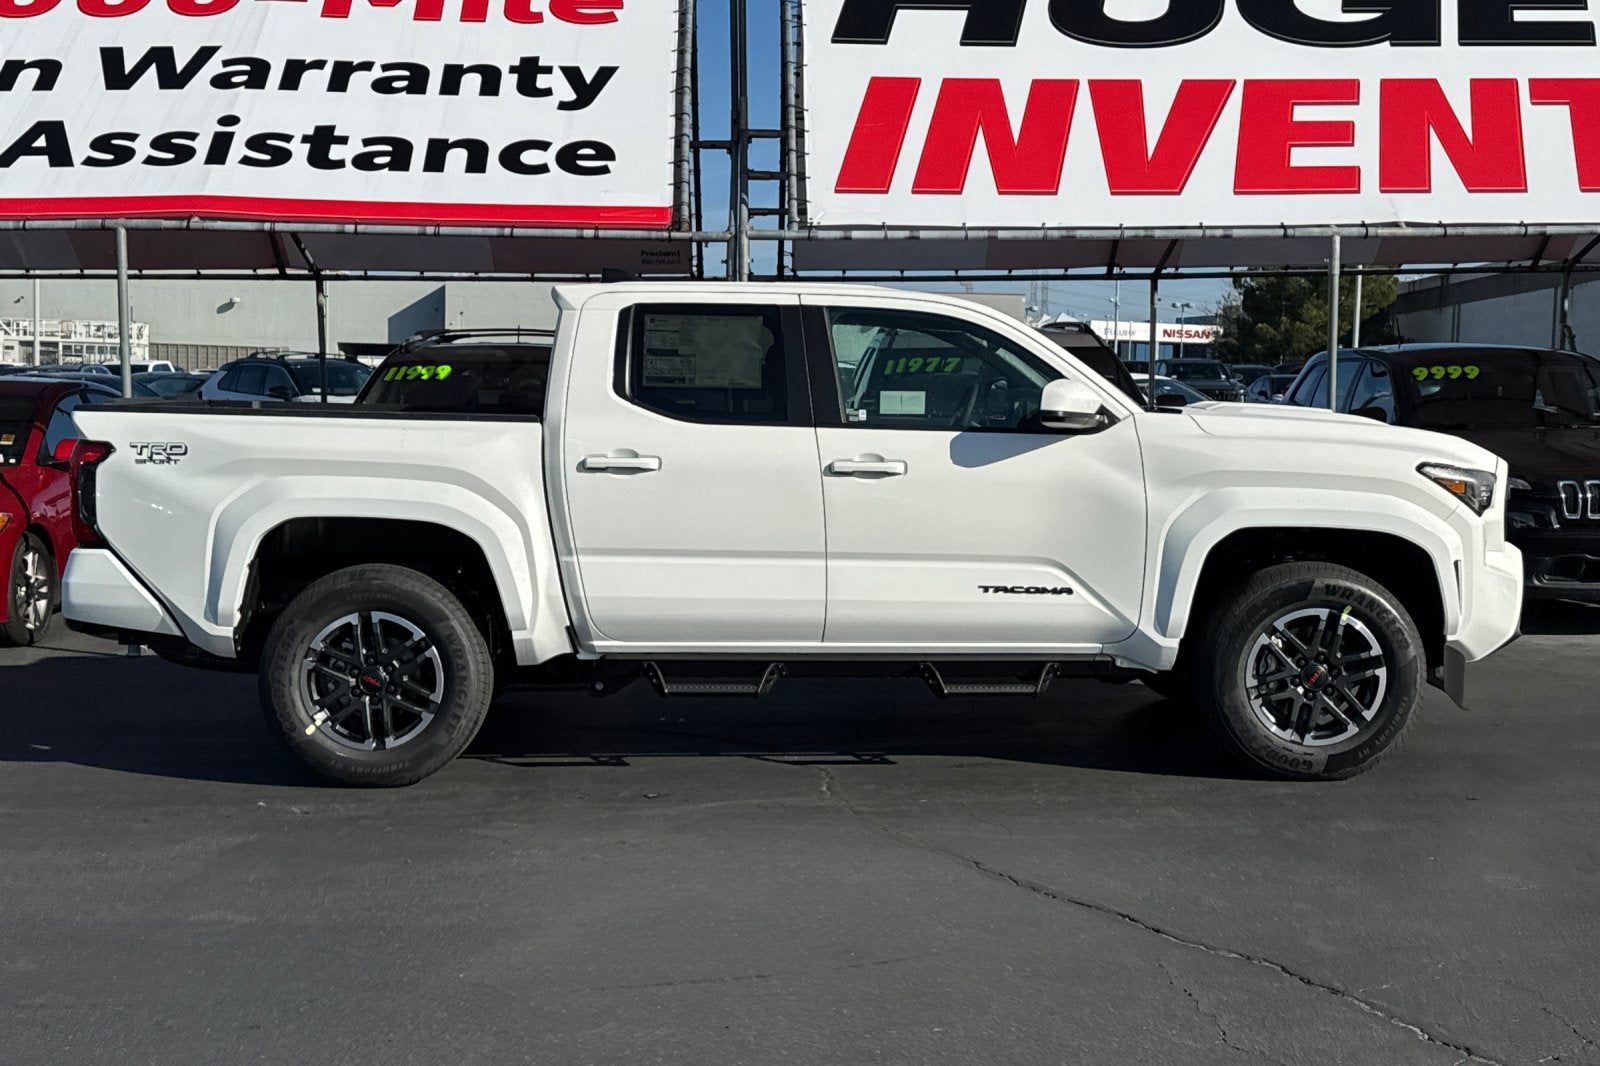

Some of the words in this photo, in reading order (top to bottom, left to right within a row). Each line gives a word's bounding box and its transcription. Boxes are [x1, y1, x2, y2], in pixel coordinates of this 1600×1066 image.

[100, 46, 619, 111] Warranty
[0, 114, 617, 177] Assistance
[1163, 329, 1211, 339] NISSAN
[383, 364, 452, 381] 11999
[884, 357, 961, 375] 11977
[1412, 365, 1480, 381] 9999
[129, 442, 188, 460] TRD
[977, 585, 1074, 596] TACOMA
[1324, 582, 1410, 649] WRANGLER
